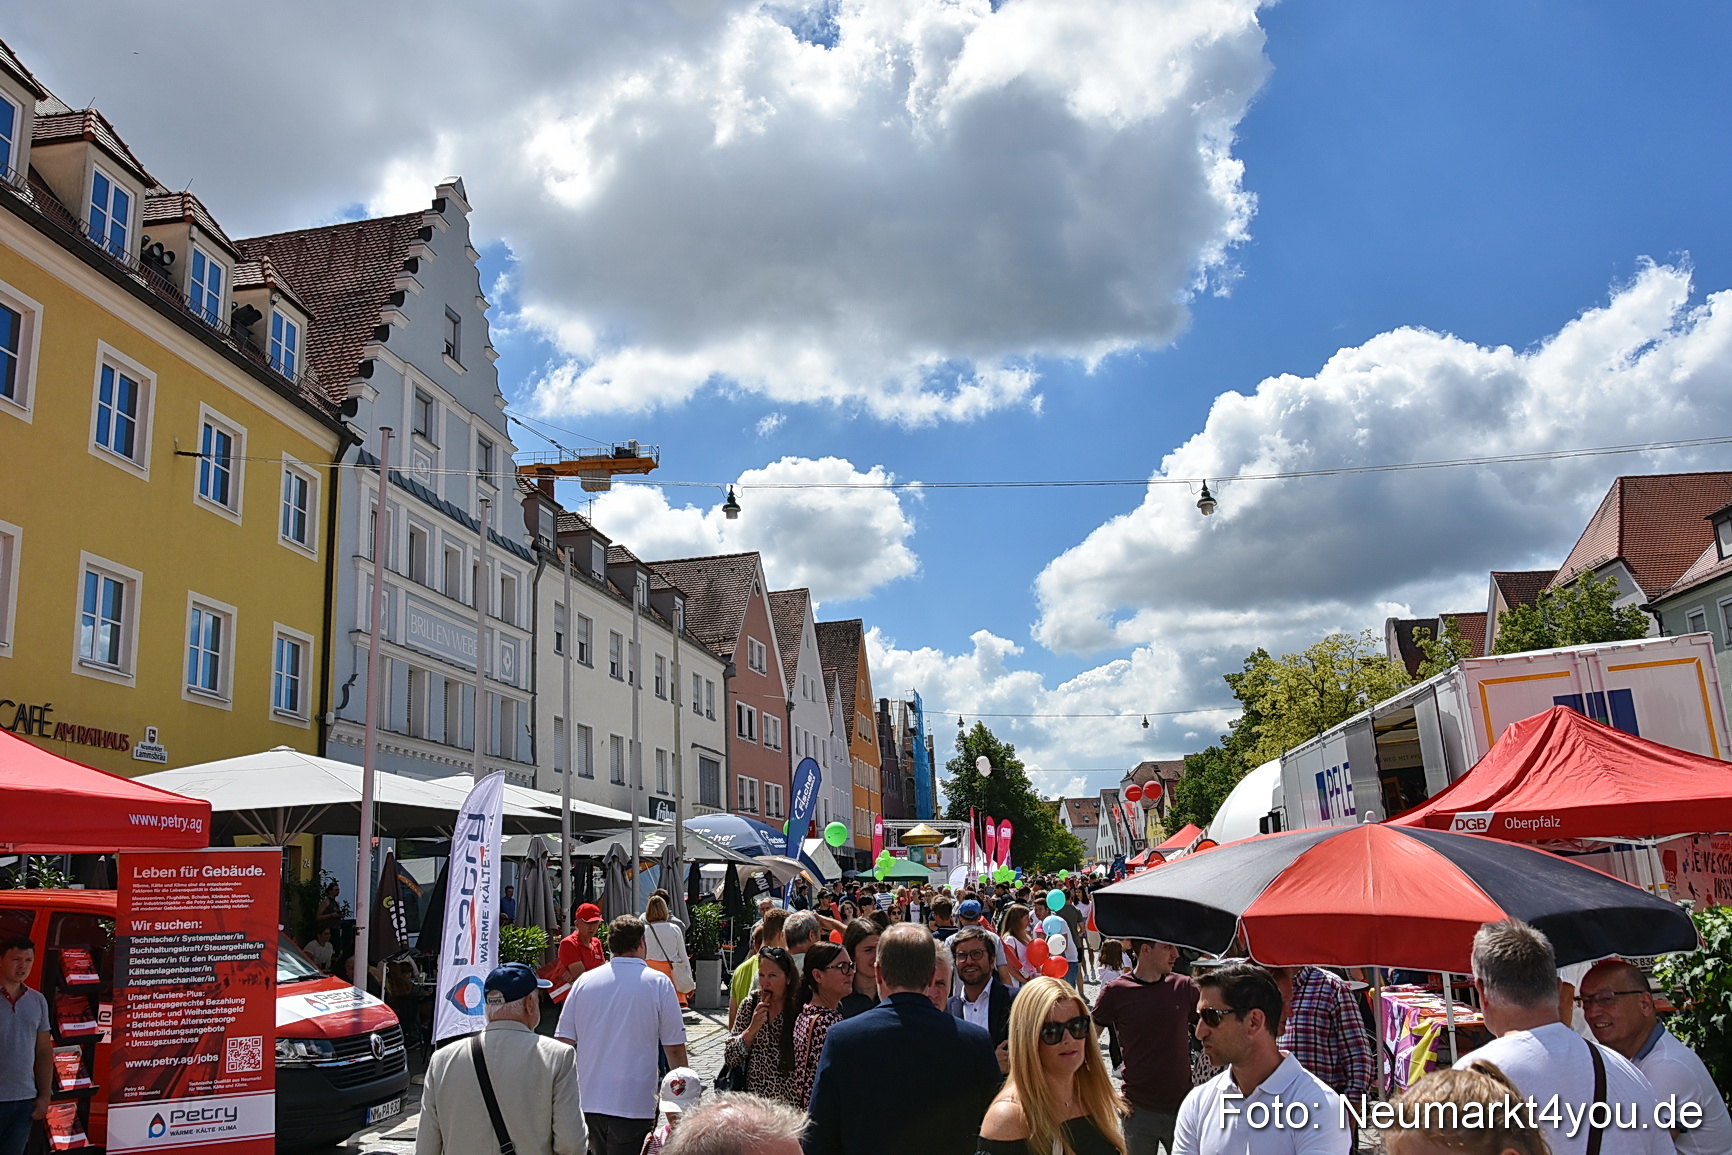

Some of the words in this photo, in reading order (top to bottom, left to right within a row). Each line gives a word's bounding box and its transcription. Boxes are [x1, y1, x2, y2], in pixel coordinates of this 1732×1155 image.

[411, 614, 451, 647] BRILLEN
[0, 700, 53, 738] CAFÉ
[54, 722, 76, 742] AM
[78, 725, 130, 751] RATHAUS
[136, 749, 166, 761] Lammsbräu
[129, 814, 202, 833] www.petry.ag
[1455, 818, 1487, 830] DGB
[1504, 815, 1560, 831] Oberpfalz
[133, 867, 176, 878] Leben
[180, 866, 199, 878] für
[202, 865, 266, 877] Gebäude.
[481, 860, 490, 904] KÄLTE
[131, 921, 152, 931] Wir
[154, 920, 202, 930] suchen:
[182, 933, 244, 943] Systemplaner/in
[479, 910, 489, 963] WÄRME
[130, 943, 264, 954] Buchhaltungskraft/Steuergehilfe/in
[129, 957, 177, 965] Elektriker/in
[208, 953, 259, 962] Kundendienst
[129, 965, 212, 975] Kälteanlagenbauer/in
[128, 975, 215, 986] Anlagenmechaniker/in
[152, 991, 205, 1000] Karriere-Plus:
[132, 999, 204, 1010] Leistungsgerechte
[206, 997, 246, 1006] Bezahlung
[184, 1006, 244, 1016] Weihnachtsgeld
[132, 1019, 178, 1028] Betriebliche
[180, 1016, 236, 1026] Altersvorsorge
[132, 1025, 225, 1038] Weiterbildungsangebote
[131, 1037, 199, 1048] Umzugszuschuss
[125, 1054, 219, 1068] www.petry.ag/jobs
[170, 1106, 238, 1124] Petry
